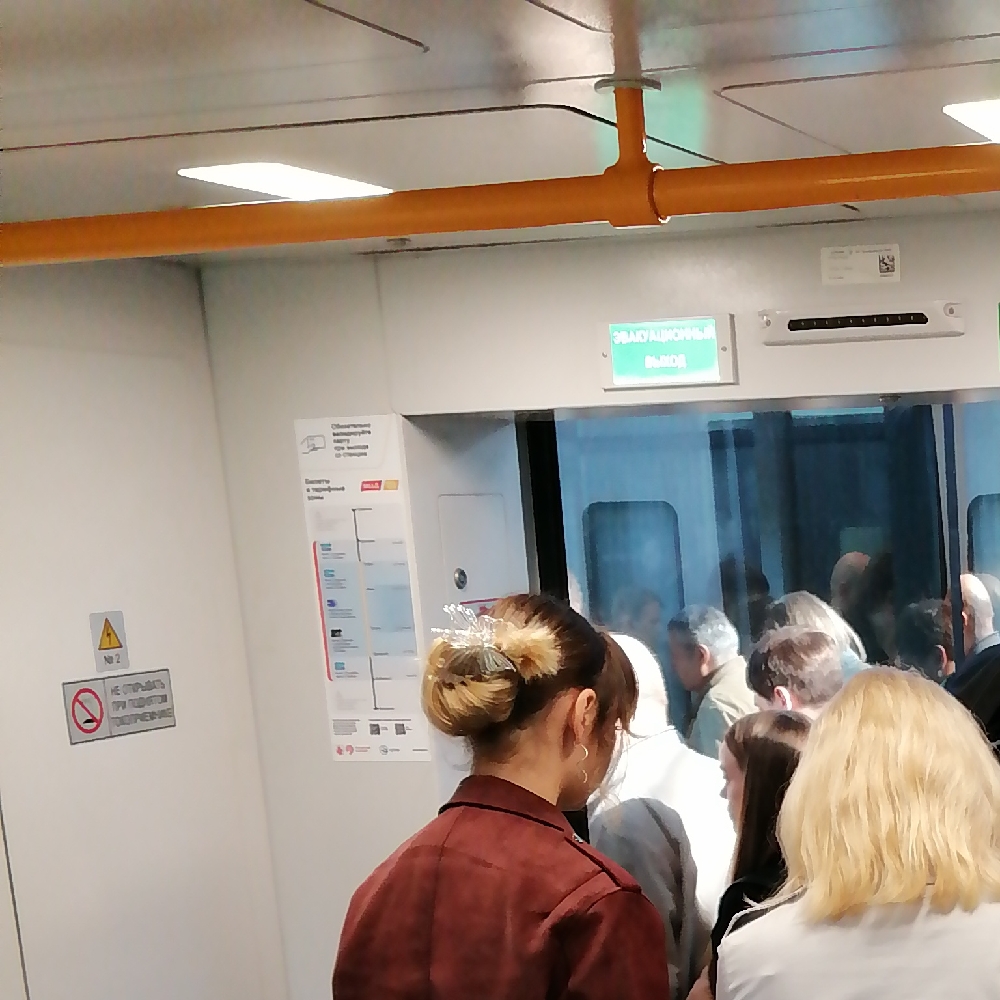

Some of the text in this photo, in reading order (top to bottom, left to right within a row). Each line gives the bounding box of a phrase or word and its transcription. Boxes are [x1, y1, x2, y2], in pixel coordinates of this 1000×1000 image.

[612, 324, 715, 345] ЭВАКУАЦИОННЫЙ
[644, 354, 687, 368] ВЫХОД
[115, 653, 121, 664] 2
[111, 685, 120, 695] НЕ
